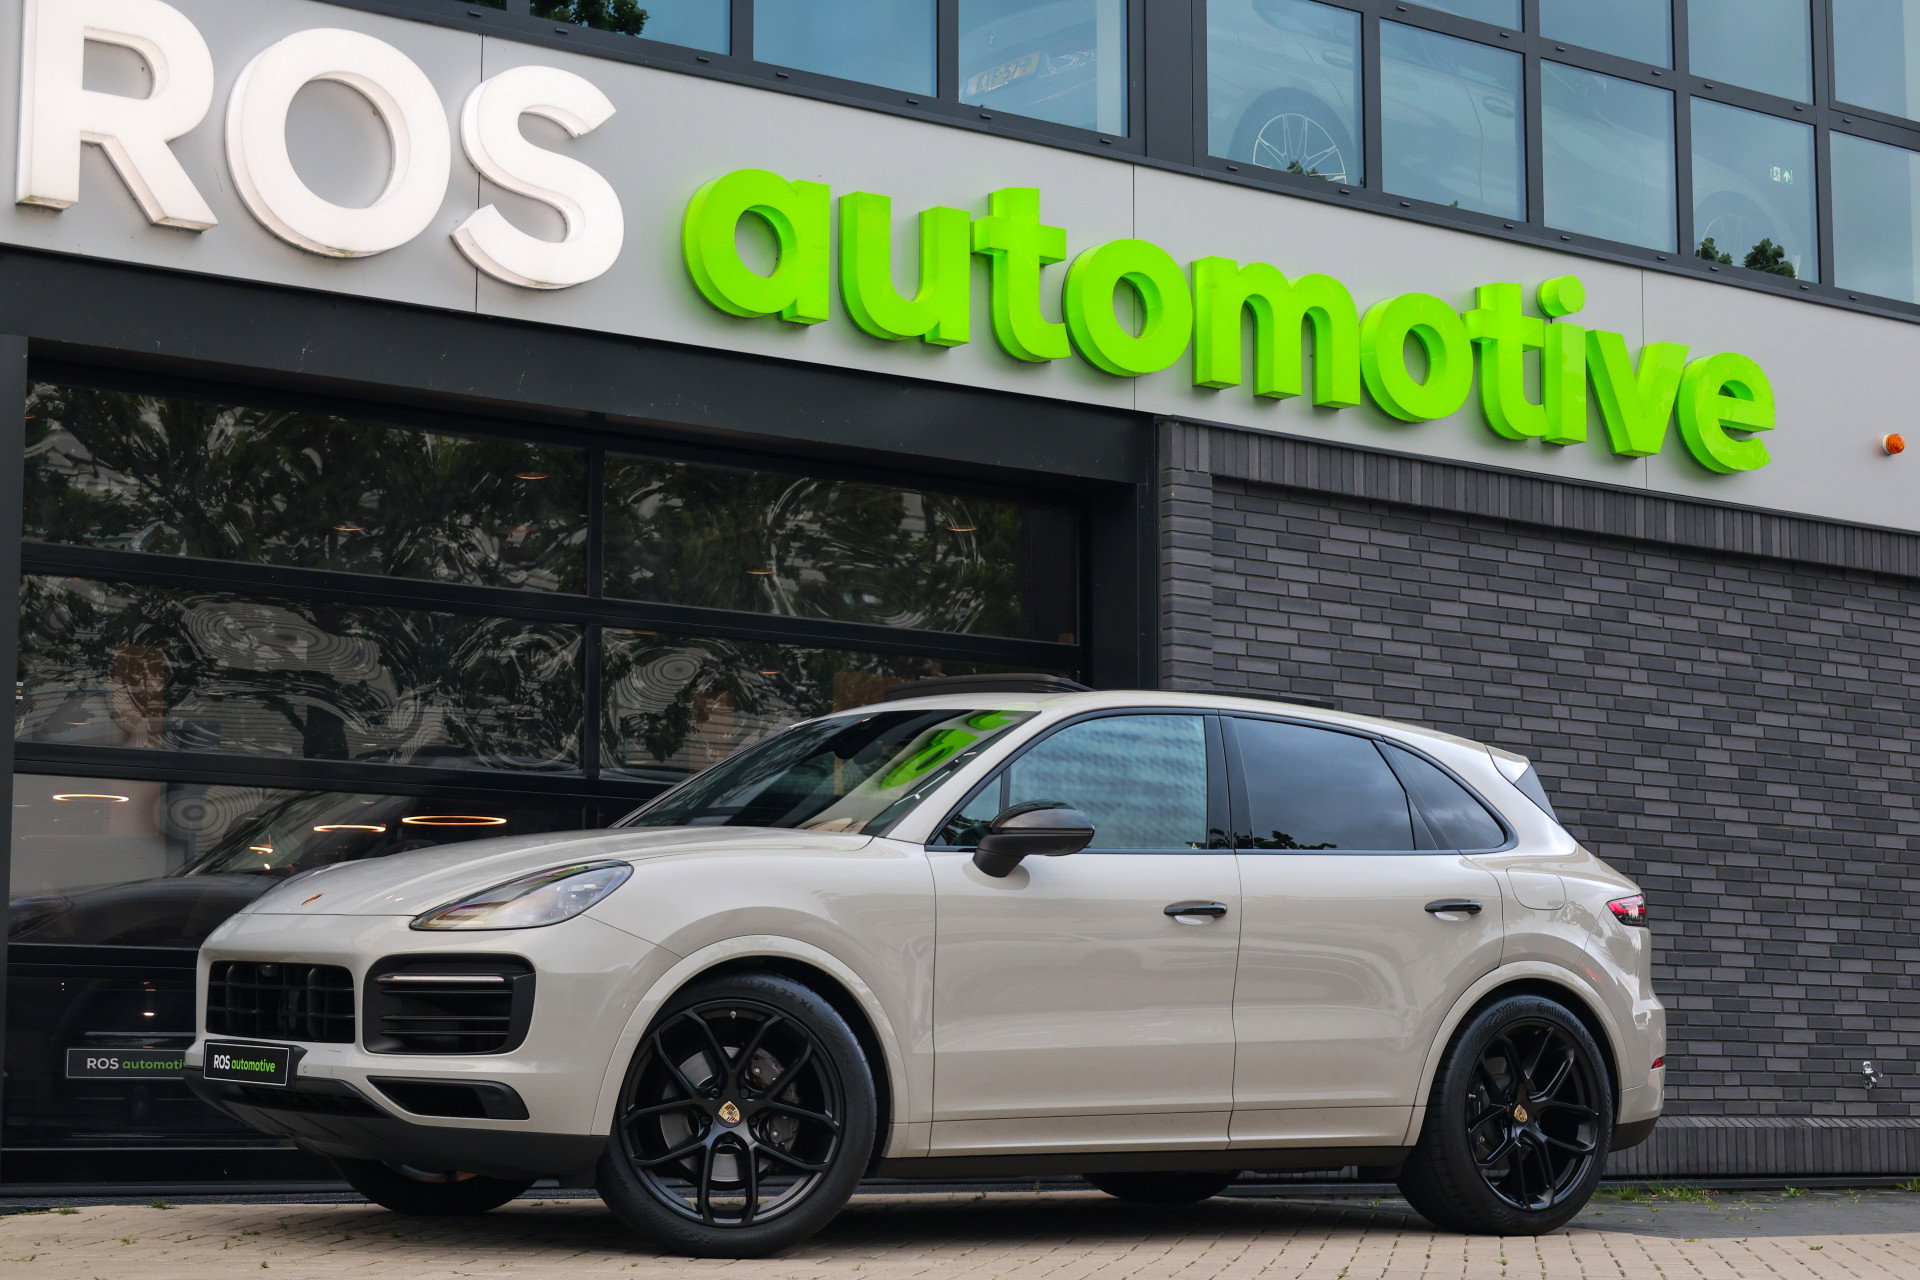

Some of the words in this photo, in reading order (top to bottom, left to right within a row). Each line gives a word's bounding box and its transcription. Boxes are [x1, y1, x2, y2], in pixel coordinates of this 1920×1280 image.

[16, 0, 625, 290] ROS
[682, 168, 1776, 473] automotive
[1537, 1001, 1582, 1035] Continental
[86, 1057, 119, 1070] ROS
[213, 1054, 231, 1070] ROS
[231, 1058, 276, 1073] automotive
